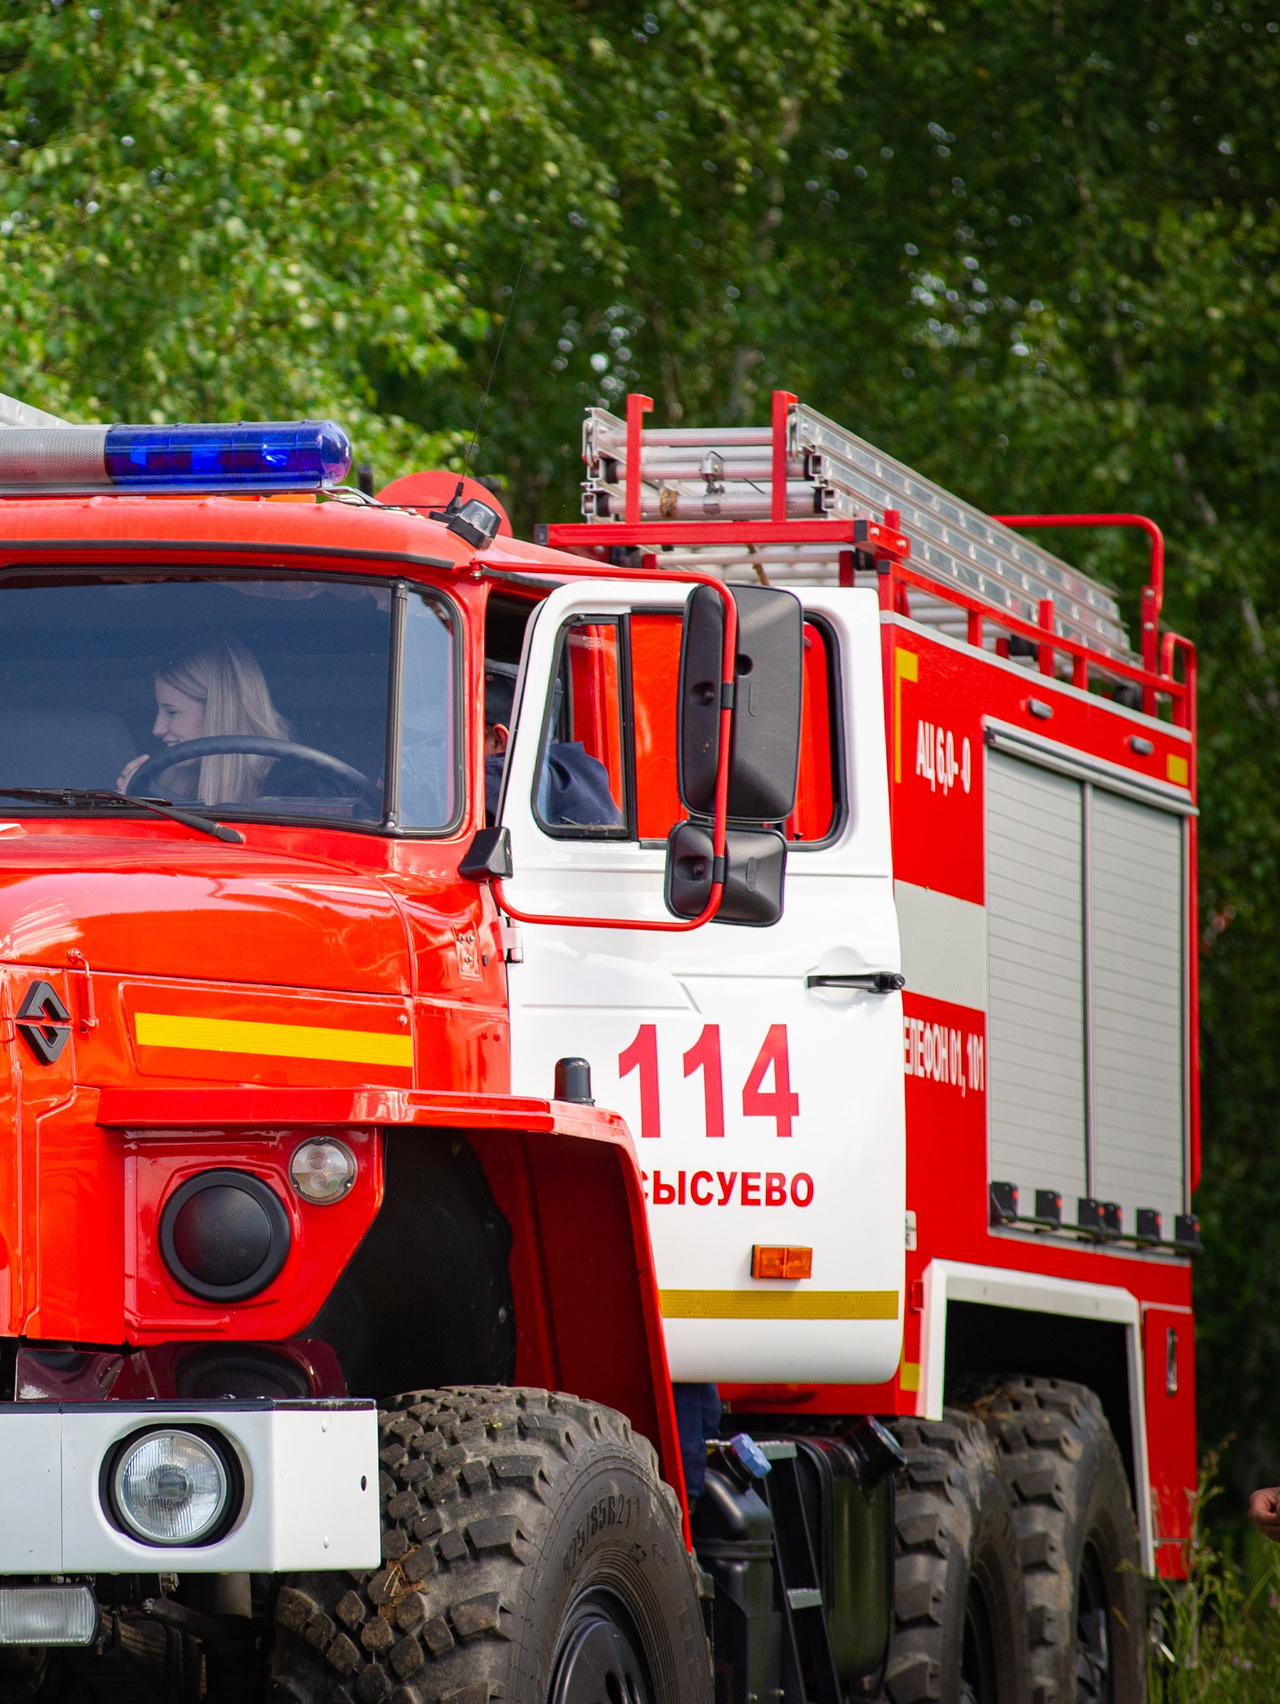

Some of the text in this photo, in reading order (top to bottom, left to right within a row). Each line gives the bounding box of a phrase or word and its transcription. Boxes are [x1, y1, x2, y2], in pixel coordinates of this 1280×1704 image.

[916, 719, 935, 793] АЦ
[618, 1023, 800, 1138] 114
[903, 1015, 985, 1099] ЕЛЕФОН 01, 101
